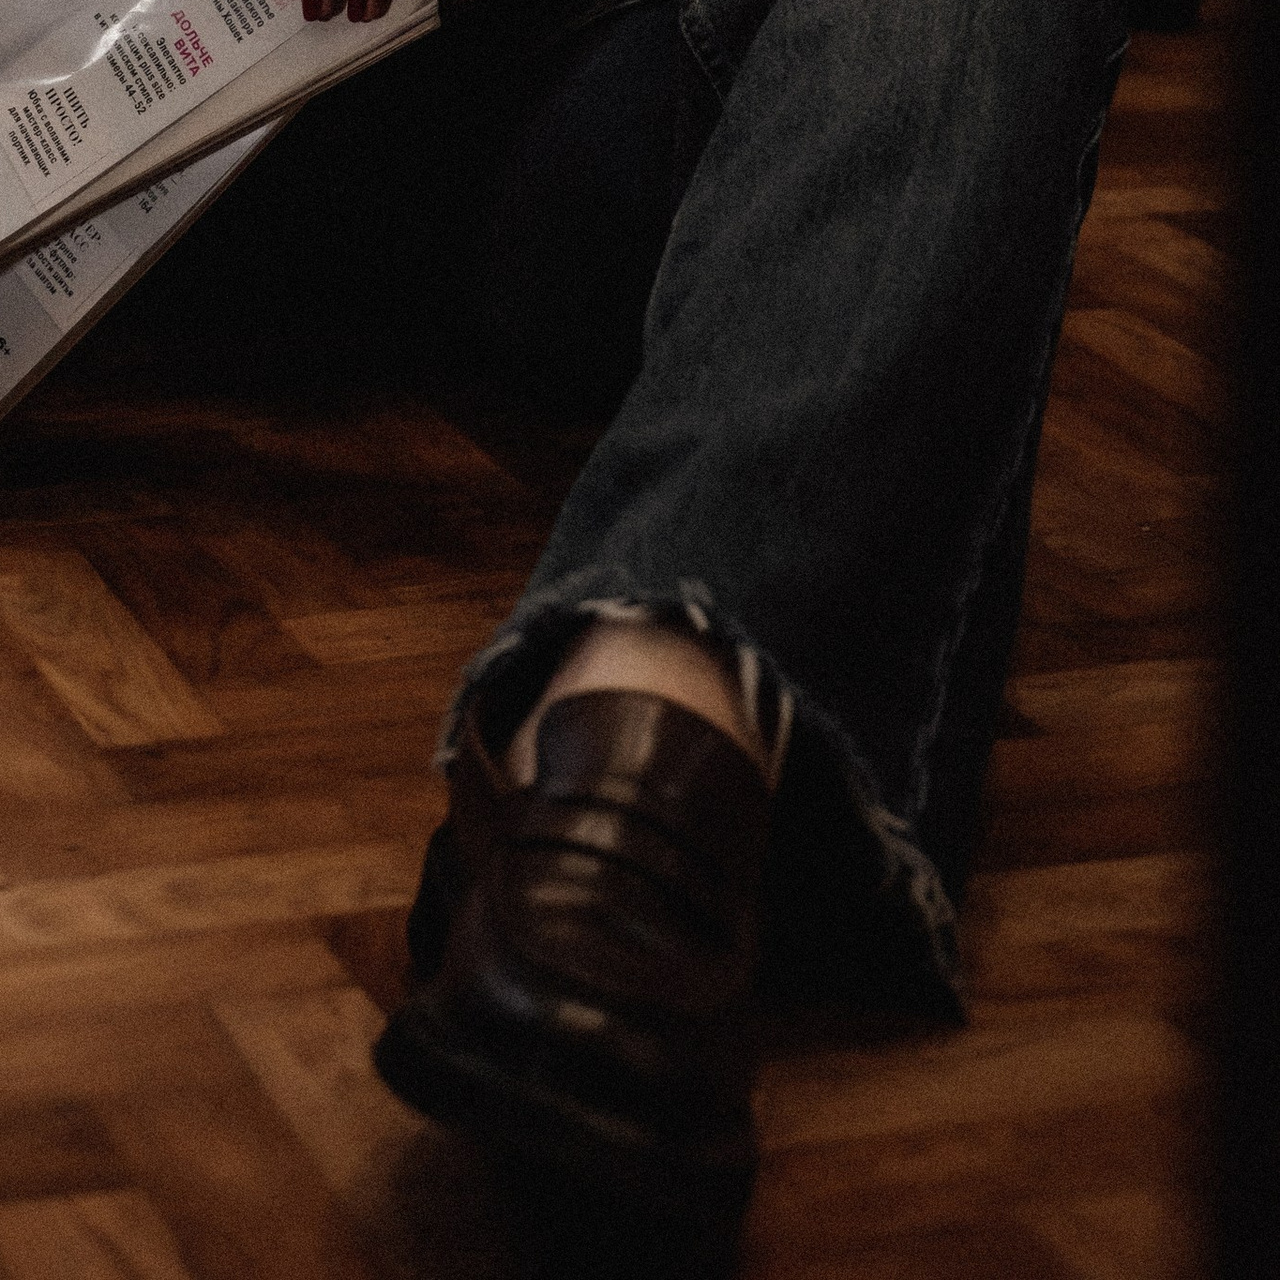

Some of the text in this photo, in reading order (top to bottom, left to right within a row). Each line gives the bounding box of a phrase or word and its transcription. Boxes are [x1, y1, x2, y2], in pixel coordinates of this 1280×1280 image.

[93, 12, 102, 20] в
[220, 10, 246, 44] Хошек
[170, 8, 214, 68] ДОЛЬЧЕ
[172, 37, 202, 77] ВИТА
[138, 60, 156, 82] plus
[150, 79, 168, 100] size
[155, 36, 188, 85] Элегантно
[26, 88, 72, 166] Юбка с воланами:
[44, 87, 83, 147] ПРОСТО!
[62, 86, 92, 129] ШИТЬ
[7, 105, 51, 177] для начинающих
[7, 130, 31, 166] портних
[21, 105, 58, 164] мастер-класс
[25, 257, 57, 294] за шагом
[51, 271, 74, 297] шитья
